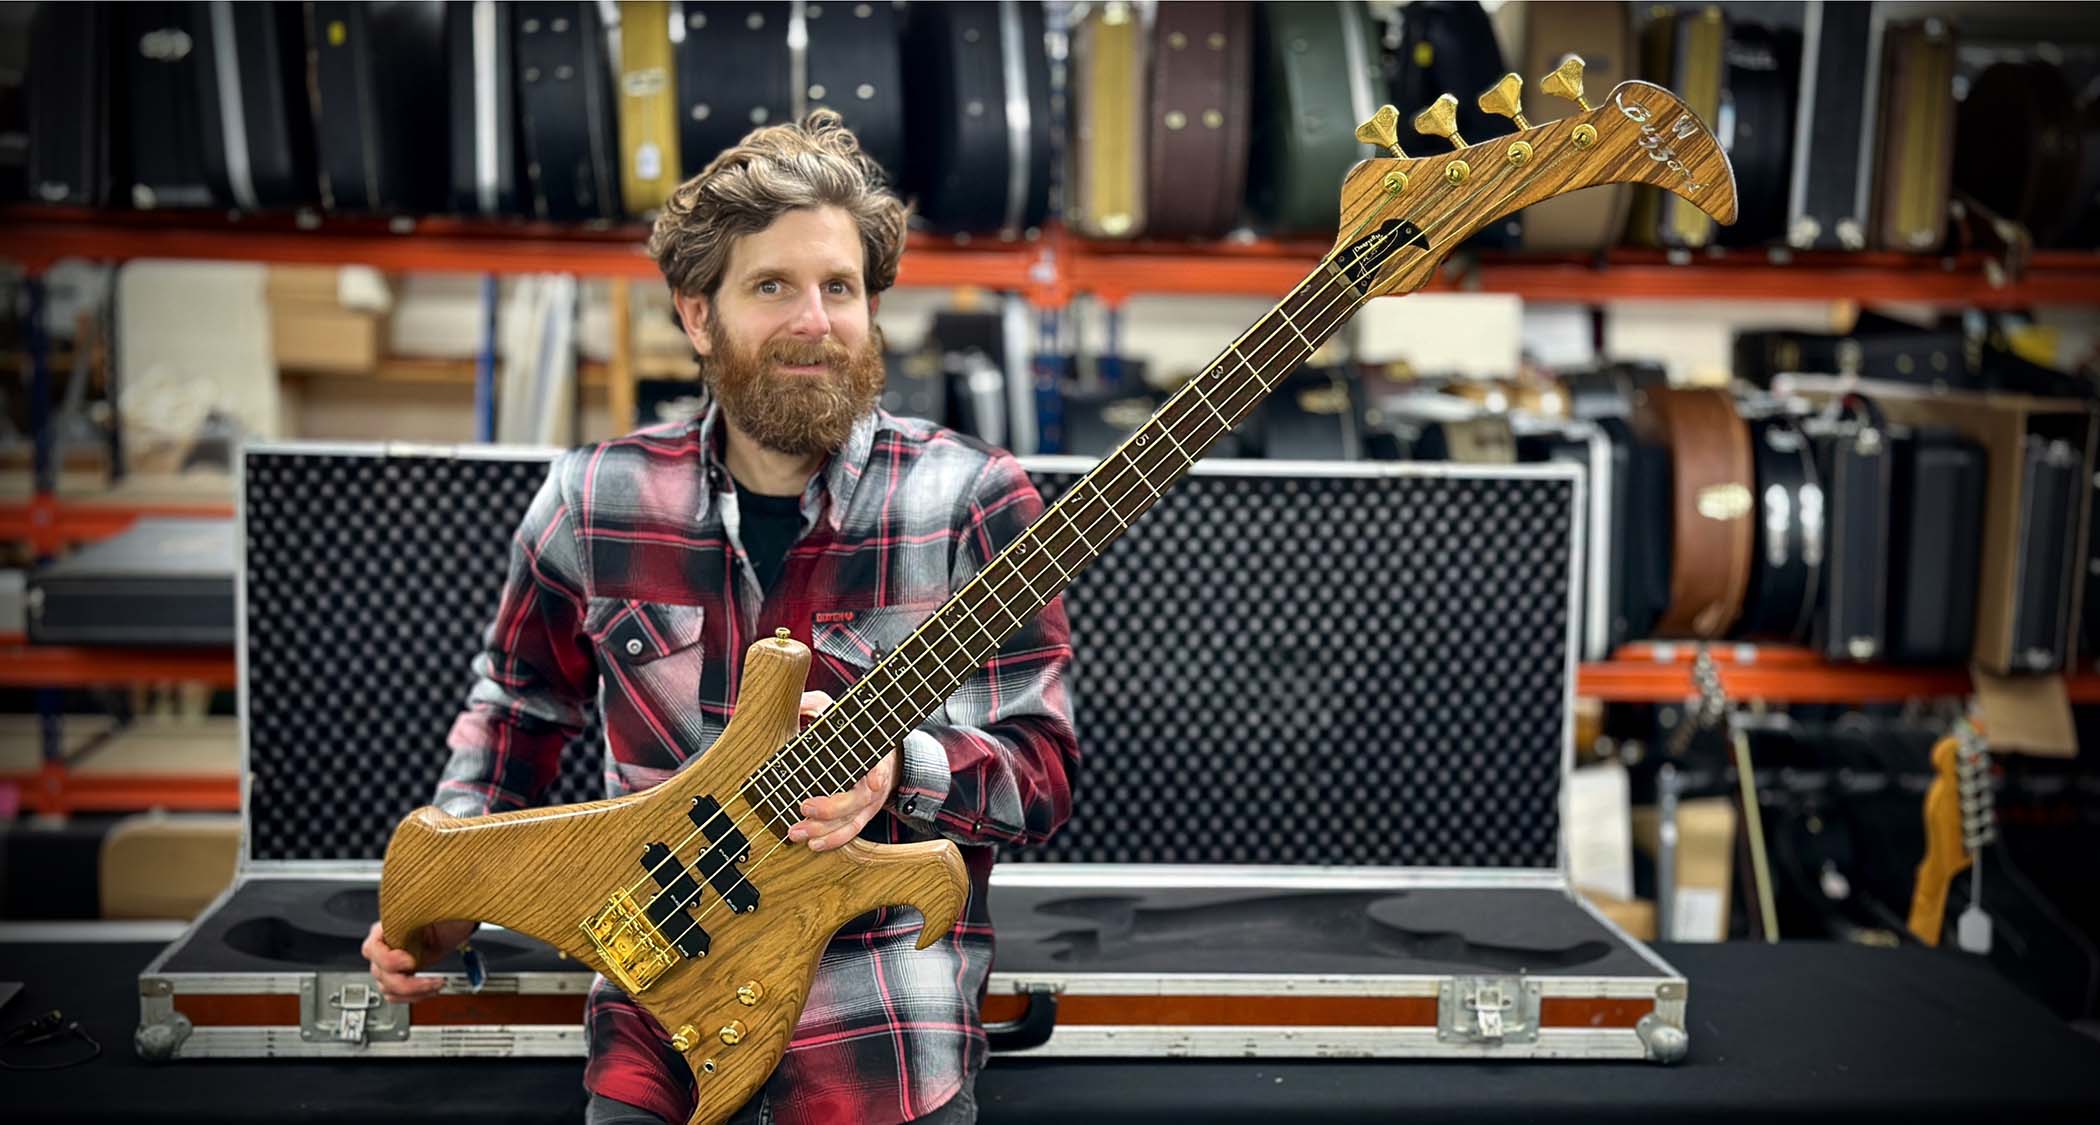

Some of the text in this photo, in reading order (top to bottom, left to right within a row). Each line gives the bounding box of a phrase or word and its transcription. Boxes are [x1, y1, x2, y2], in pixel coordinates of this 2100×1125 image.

[1672, 114, 1699, 140] W
[1210, 365, 1225, 380] 3
[1135, 433, 1150, 447] 5
[1070, 492, 1085, 504] 7
[1014, 542, 1027, 555] 9
[888, 656, 907, 677] 15
[829, 712, 845, 729] 19
[804, 733, 819, 750] 21
[773, 760, 788, 778] 24
